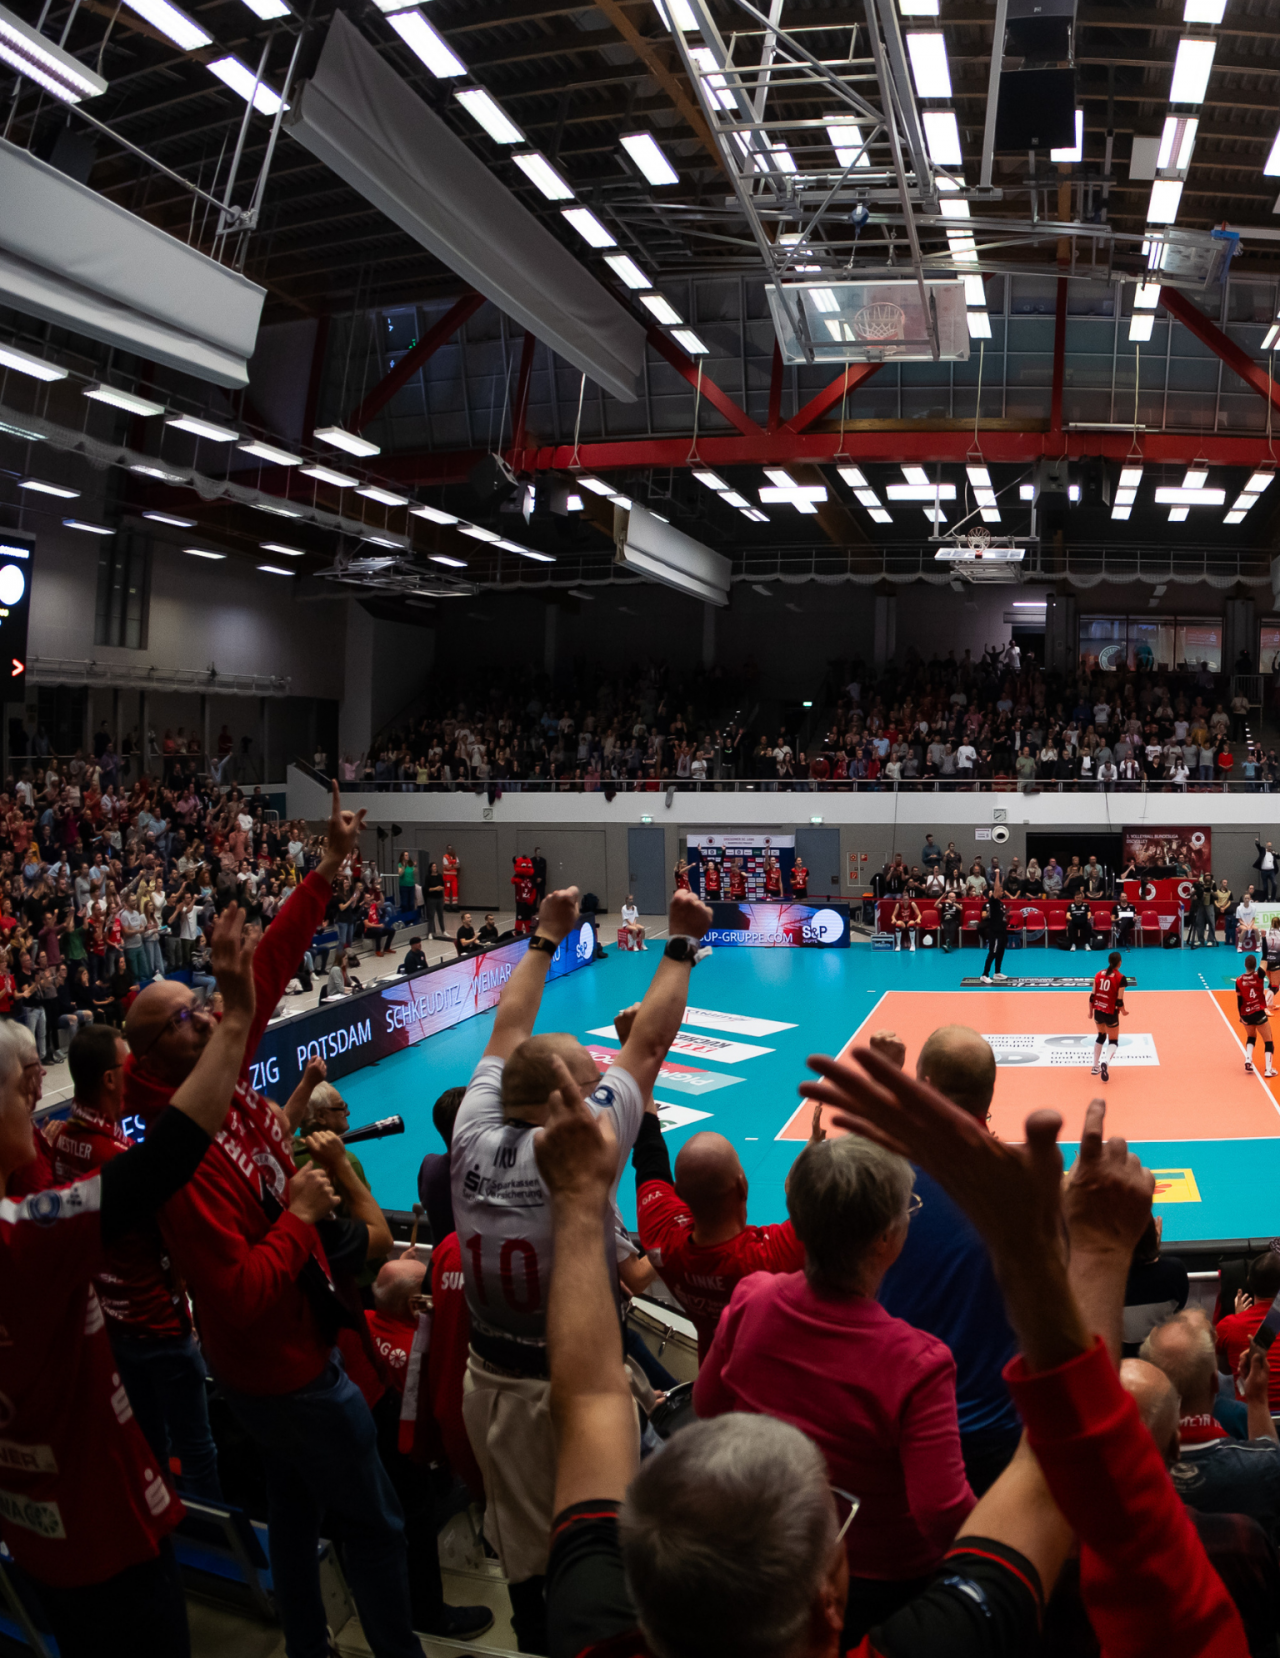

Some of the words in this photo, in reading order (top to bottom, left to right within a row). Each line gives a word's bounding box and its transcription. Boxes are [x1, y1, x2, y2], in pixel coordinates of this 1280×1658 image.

[801, 925, 828, 939] S&P
[1099, 978, 1111, 992] 10
[1249, 989, 1258, 999] 4
[248, 1056, 280, 1092] ZIG
[296, 1018, 372, 1071] POTSDAM
[385, 983, 462, 1033] SCHKEUDITZ
[471, 963, 512, 996] WEIMAR
[492, 1178, 540, 1191] Sparkassen
[465, 1232, 542, 1316] 10
